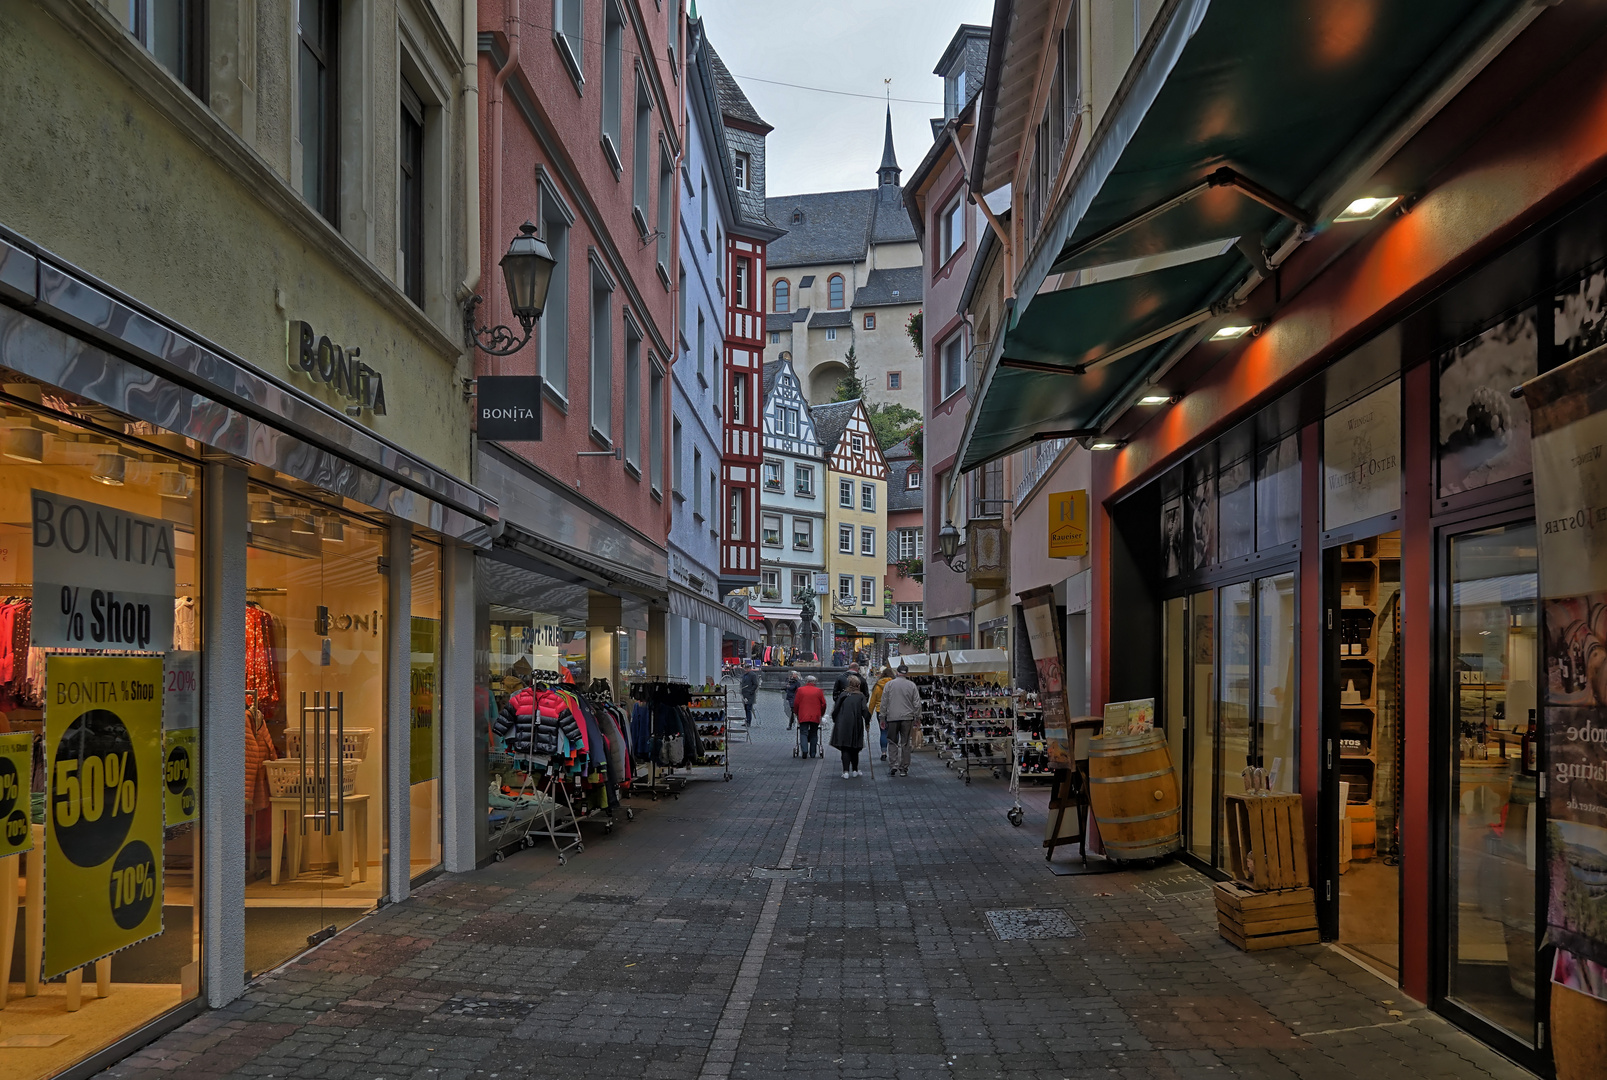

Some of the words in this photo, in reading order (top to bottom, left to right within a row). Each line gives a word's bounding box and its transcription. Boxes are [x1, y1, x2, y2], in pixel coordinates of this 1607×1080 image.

[483, 406, 534, 422] BONITA
[1369, 455, 1396, 475] OSTER
[33, 497, 175, 569] BONITA
[1052, 532, 1082, 541] Raueiser
[90, 589, 151, 649] Shop
[57, 681, 118, 704] BONITA
[130, 680, 154, 702] Shop
[168, 670, 197, 691] 20%
[166, 758, 189, 782] 50%
[56, 751, 135, 828] 50%
[7, 819, 27, 837] 70%
[112, 861, 154, 909] 70%
